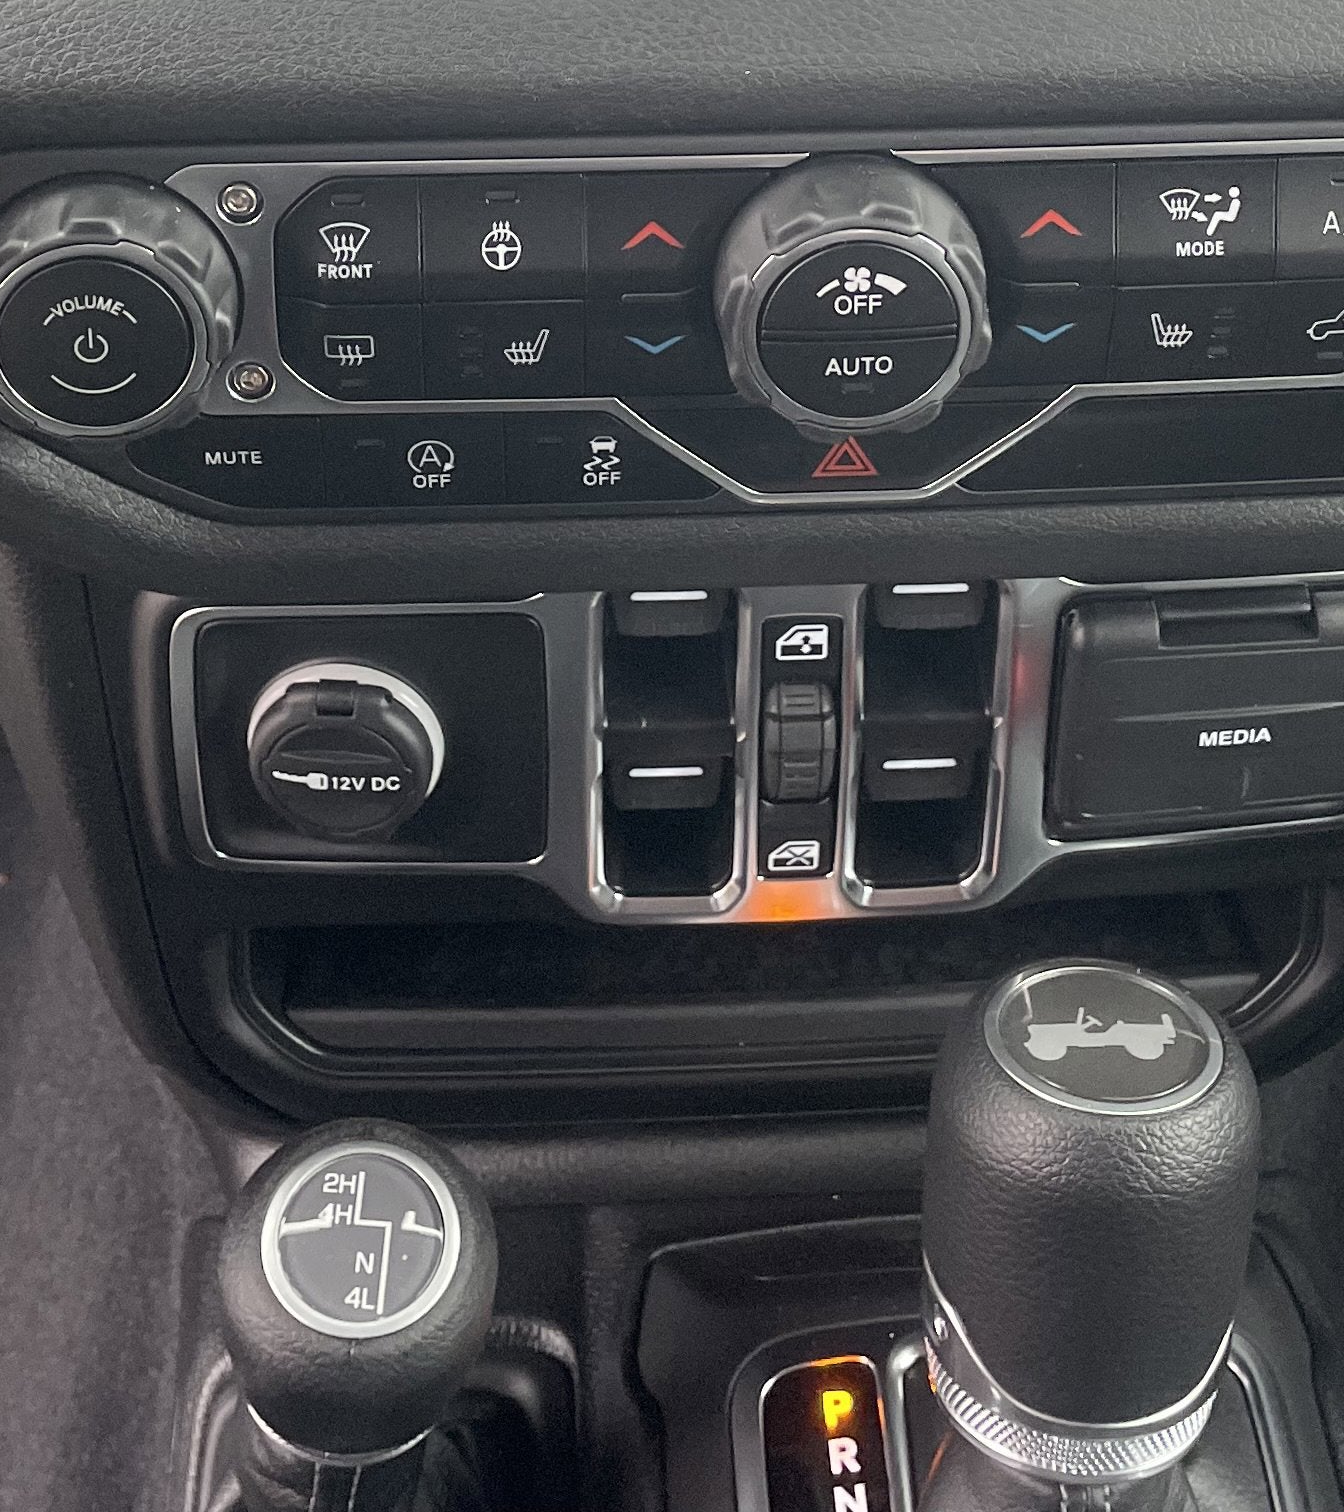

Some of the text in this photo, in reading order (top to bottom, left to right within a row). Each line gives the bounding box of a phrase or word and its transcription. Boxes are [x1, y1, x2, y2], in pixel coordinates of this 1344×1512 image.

[1175, 240, 1225, 257] MODE
[317, 264, 373, 280] FRONT
[51, 295, 124, 318] VOLUME
[833, 294, 883, 316] OFF
[824, 356, 893, 377] AUTO
[205, 450, 263, 466] MUTE
[412, 473, 451, 489] OFF
[582, 471, 622, 487] OFF
[1198, 727, 1272, 748] MEDIA
[331, 776, 401, 792] 12V DC
[322, 1172, 357, 1195] 2H
[318, 1202, 353, 1226] 4H
[354, 1251, 375, 1274] N
[344, 1286, 375, 1310] 4L
[822, 1390, 854, 1430] P
[827, 1436, 862, 1475] R
[832, 1482, 868, 1512] N
